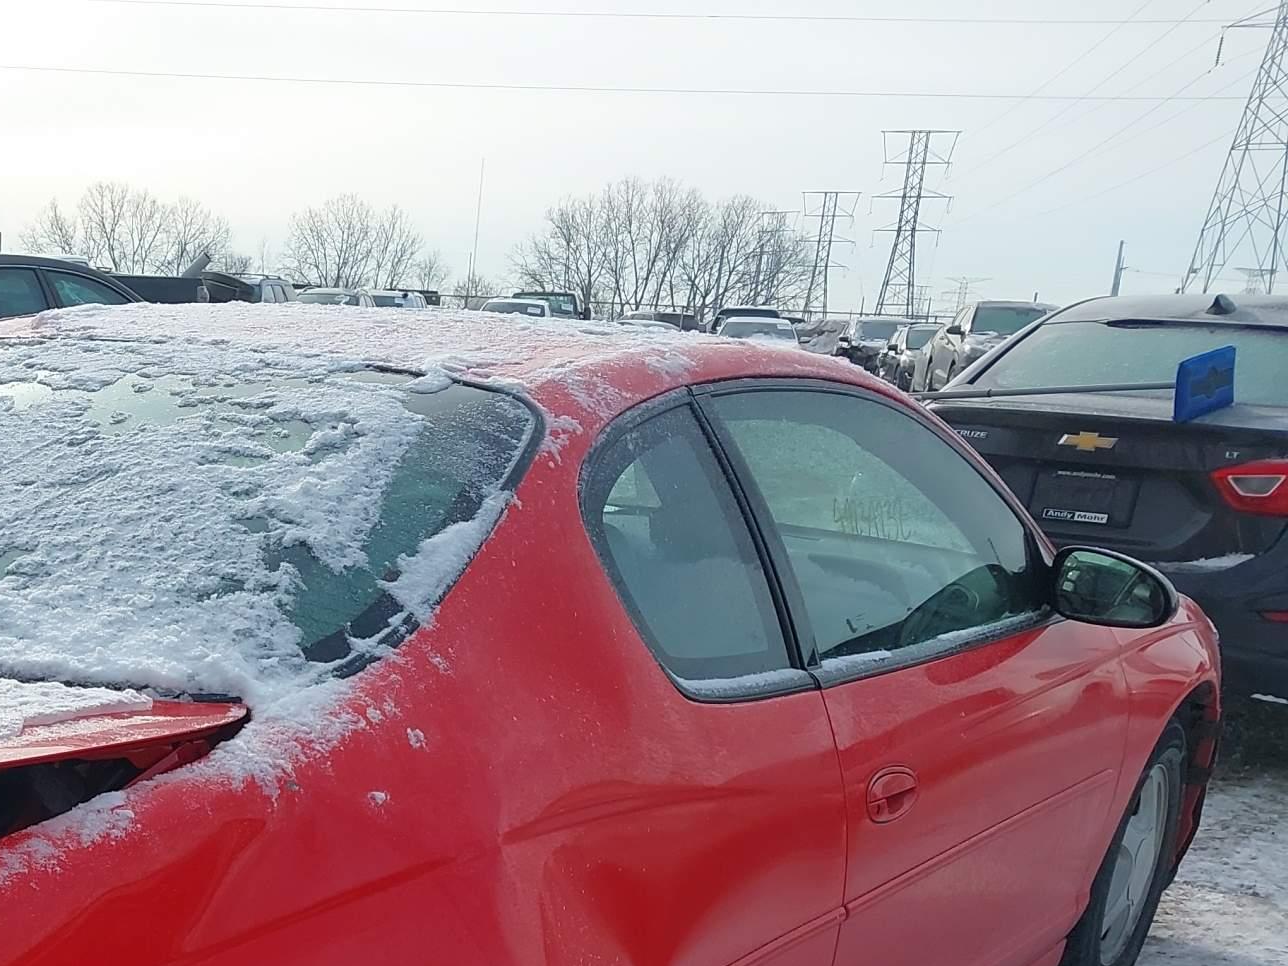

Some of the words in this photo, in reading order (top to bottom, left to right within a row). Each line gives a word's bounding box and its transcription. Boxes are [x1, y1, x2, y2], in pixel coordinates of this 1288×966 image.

[1224, 450, 1241, 460] LT
[1046, 509, 1074, 519] Andy
[1075, 511, 1107, 522] Mohr
